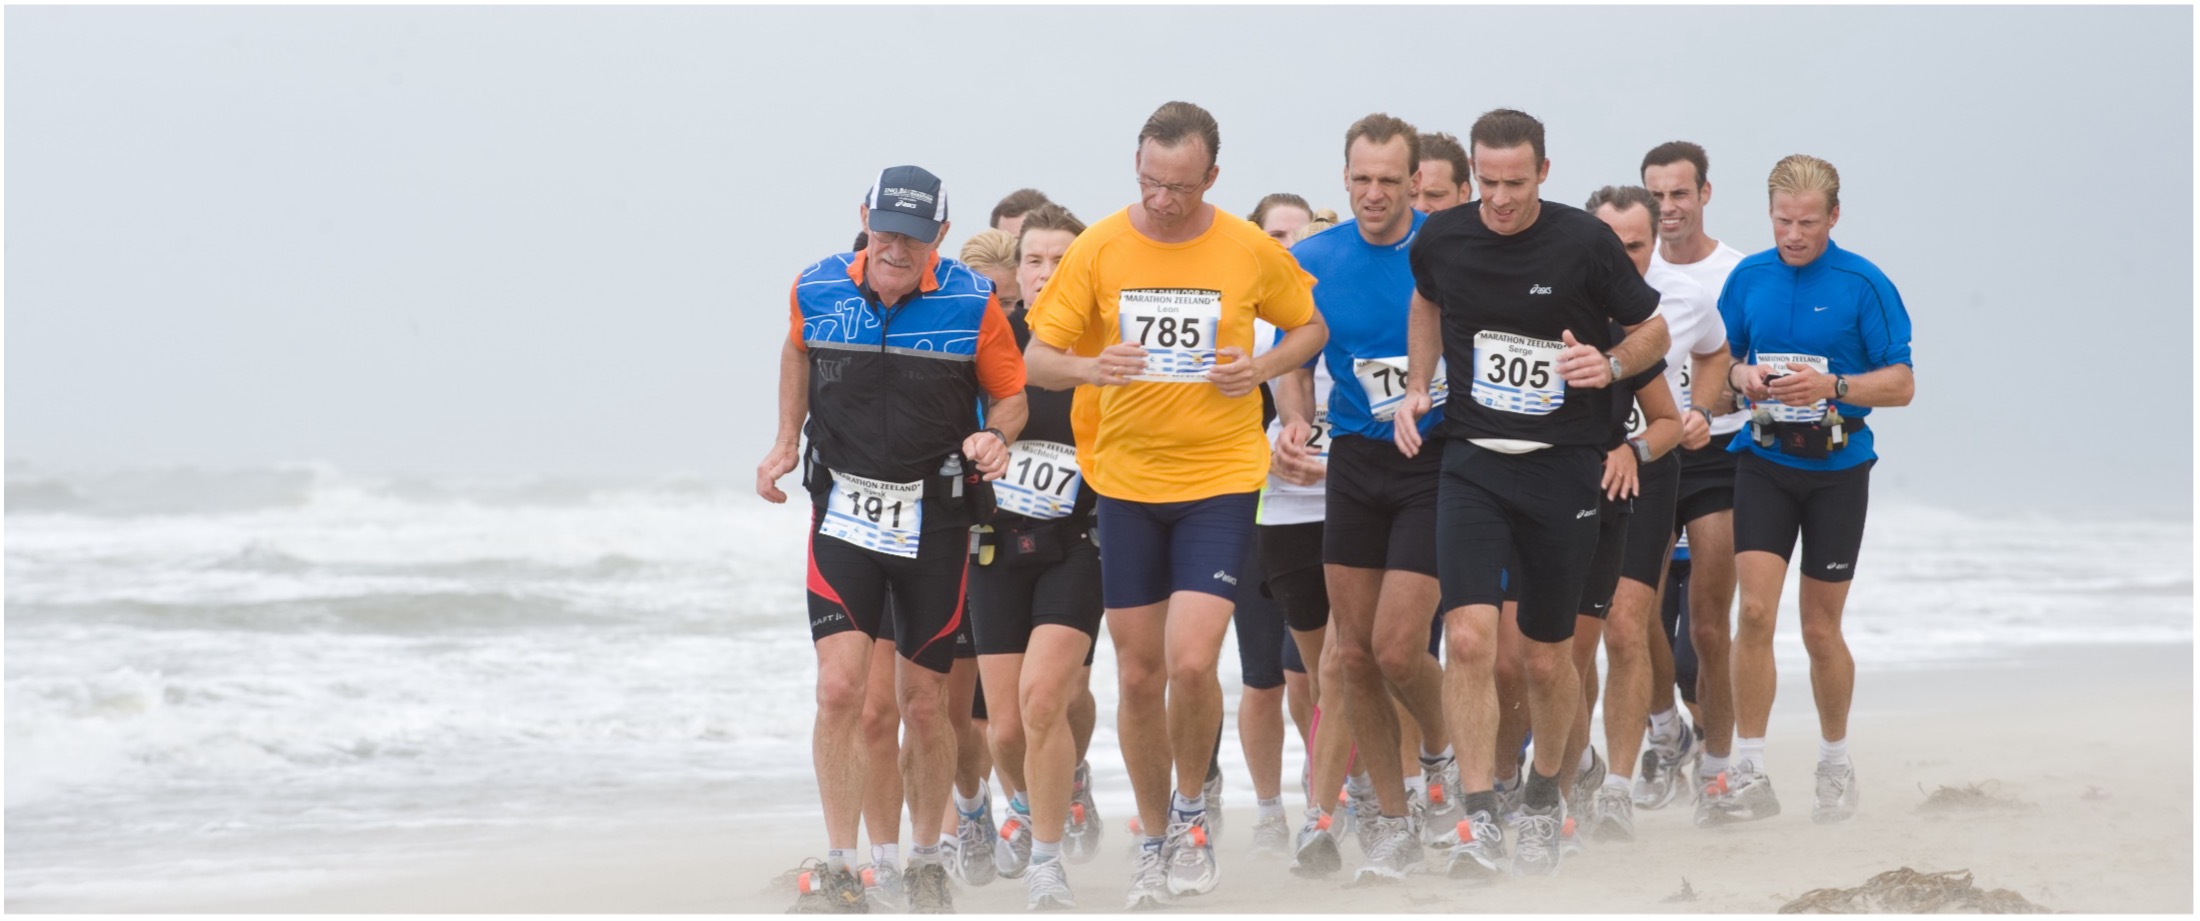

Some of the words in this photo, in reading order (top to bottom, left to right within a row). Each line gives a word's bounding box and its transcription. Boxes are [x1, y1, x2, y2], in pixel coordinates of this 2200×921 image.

[1157, 305, 1179, 313] Leon
[1136, 315, 1200, 348] 785
[1508, 344, 1533, 357] Serge
[1487, 353, 1550, 389] 305
[847, 491, 902, 528] 191
[811, 614, 834, 629] RAFT
